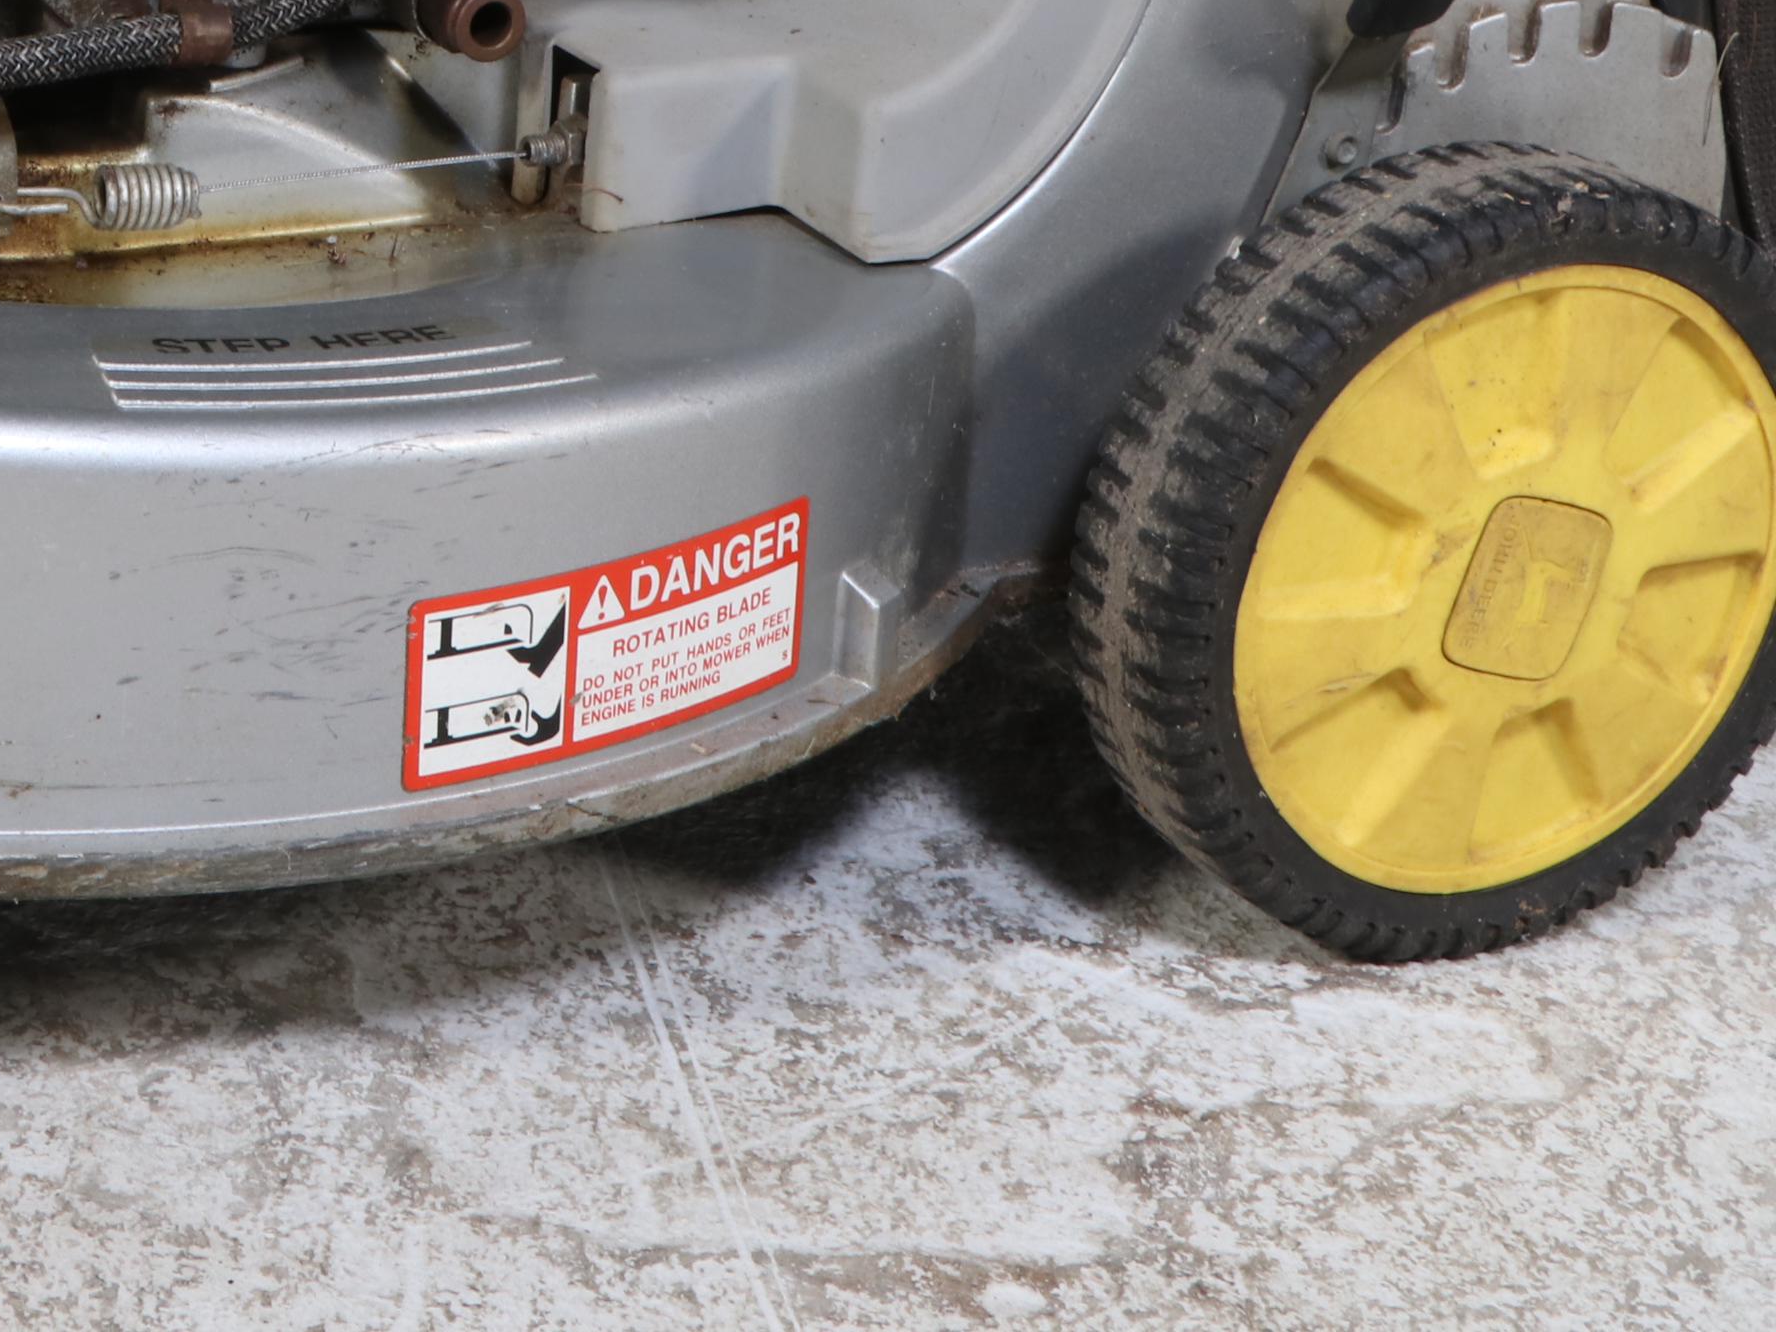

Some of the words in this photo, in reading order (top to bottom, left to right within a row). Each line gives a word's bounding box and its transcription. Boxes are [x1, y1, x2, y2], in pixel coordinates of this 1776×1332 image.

[151, 335, 291, 356] STEP
[308, 324, 455, 352] HERE
[630, 512, 801, 610] DANGER
[583, 677, 605, 692] DO
[613, 667, 643, 685] NOT
[651, 652, 679, 673] PUT
[686, 633, 732, 662] HANDS
[738, 624, 757, 642] OR
[762, 608, 792, 631] FEET
[613, 612, 710, 657] ROTATING
[717, 586, 772, 623] BLADE
[581, 699, 636, 726] ENGINE
[641, 690, 655, 709] IS
[660, 671, 721, 703] RUNNING
[582, 685, 633, 710] UNDER
[639, 677, 660, 693] OR
[665, 661, 697, 684] INTO
[702, 641, 751, 673] MOWER
[756, 625, 790, 652] WHEN
